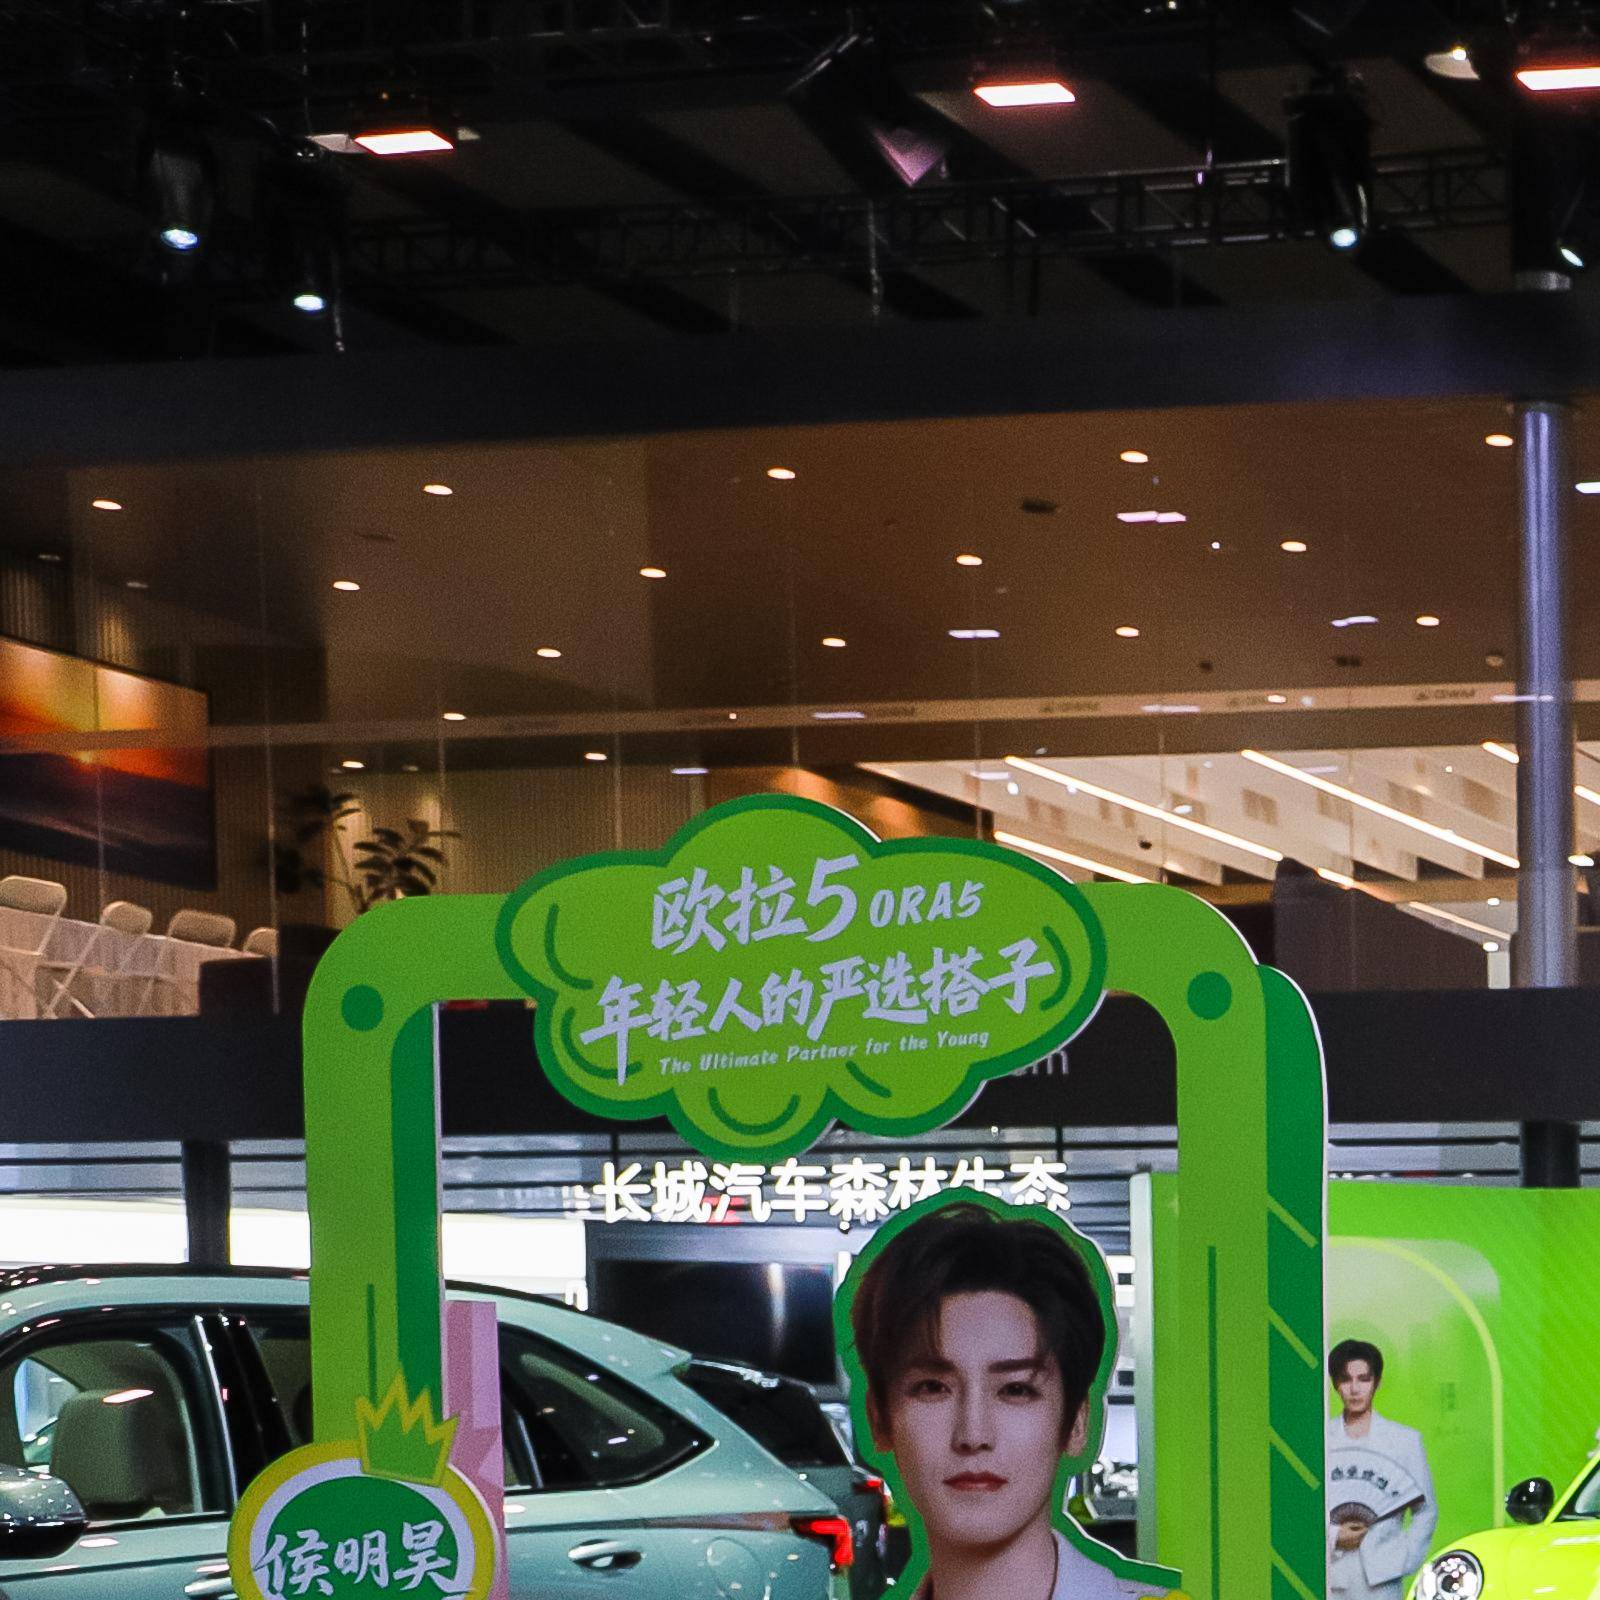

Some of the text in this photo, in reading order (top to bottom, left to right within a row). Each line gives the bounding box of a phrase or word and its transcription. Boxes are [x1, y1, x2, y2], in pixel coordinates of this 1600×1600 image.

[651, 854, 985, 955] 欧拉5 ORA5
[579, 937, 1056, 1085] 年轻人的严选搭子
[659, 1030, 990, 1074] The Ultimate Partner for the Young
[255, 1521, 475, 1596] 侯明昊
